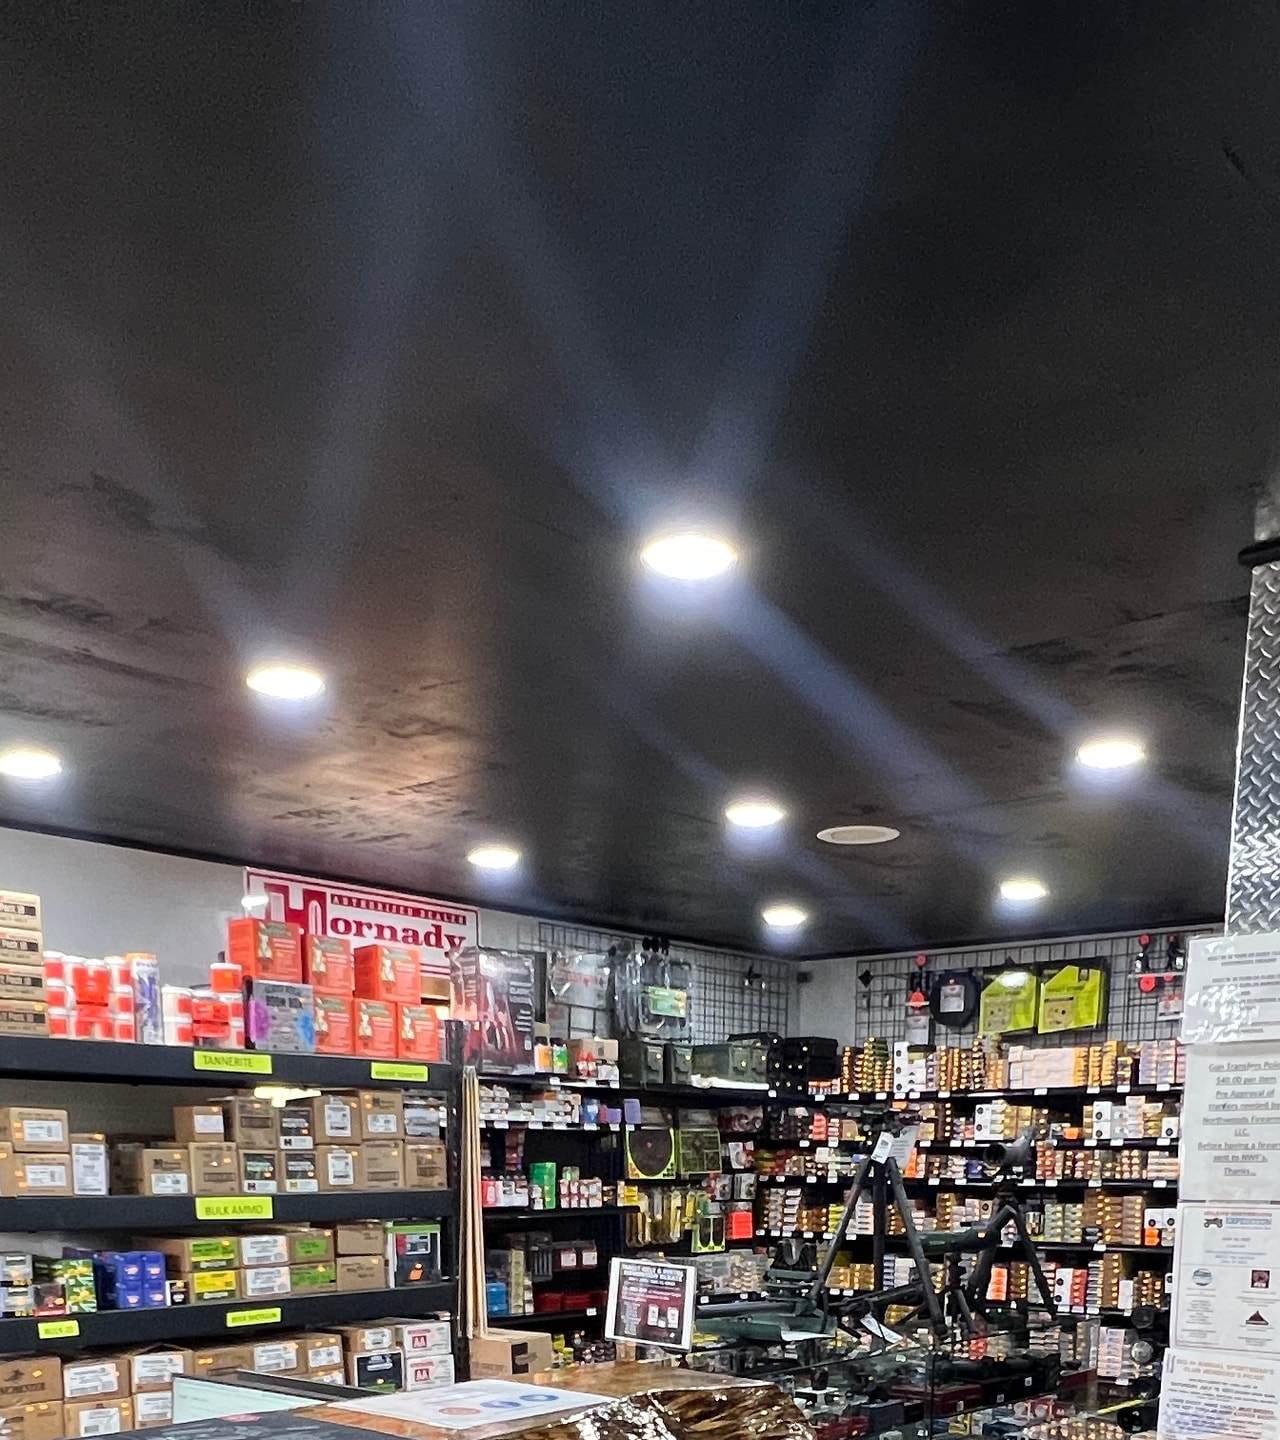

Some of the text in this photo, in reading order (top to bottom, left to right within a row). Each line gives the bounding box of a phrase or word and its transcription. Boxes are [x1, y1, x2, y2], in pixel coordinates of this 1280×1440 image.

[264, 882, 467, 955] Hornady
[331, 894, 467, 926] AUTHORIZED DEALER
[202, 1055, 254, 1068] TANNERITE
[205, 1206, 230, 1216] BULK
